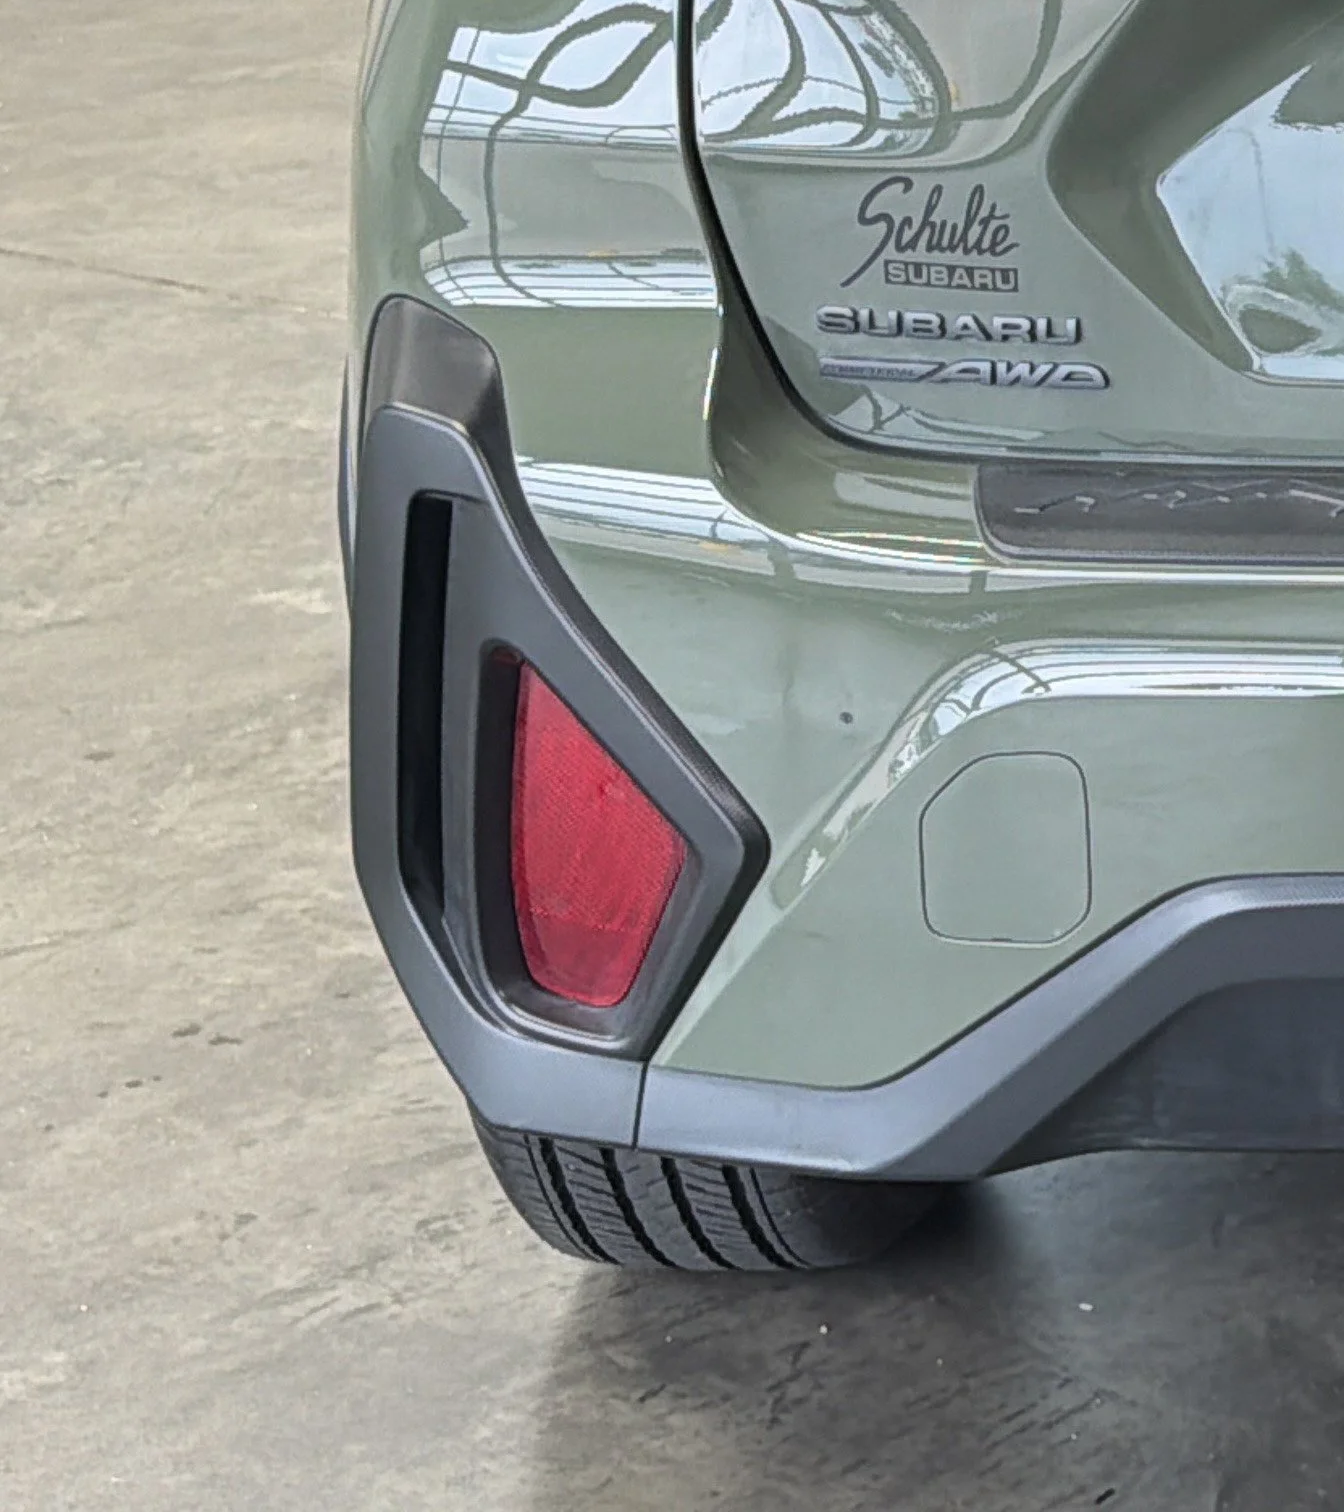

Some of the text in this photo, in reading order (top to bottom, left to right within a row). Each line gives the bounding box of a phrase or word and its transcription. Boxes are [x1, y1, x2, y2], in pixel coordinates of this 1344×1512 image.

[840, 175, 1020, 288] Schulte
[886, 261, 1016, 291] SUBARU
[816, 304, 1082, 345] SUBARU
[930, 358, 1110, 389] AWD
